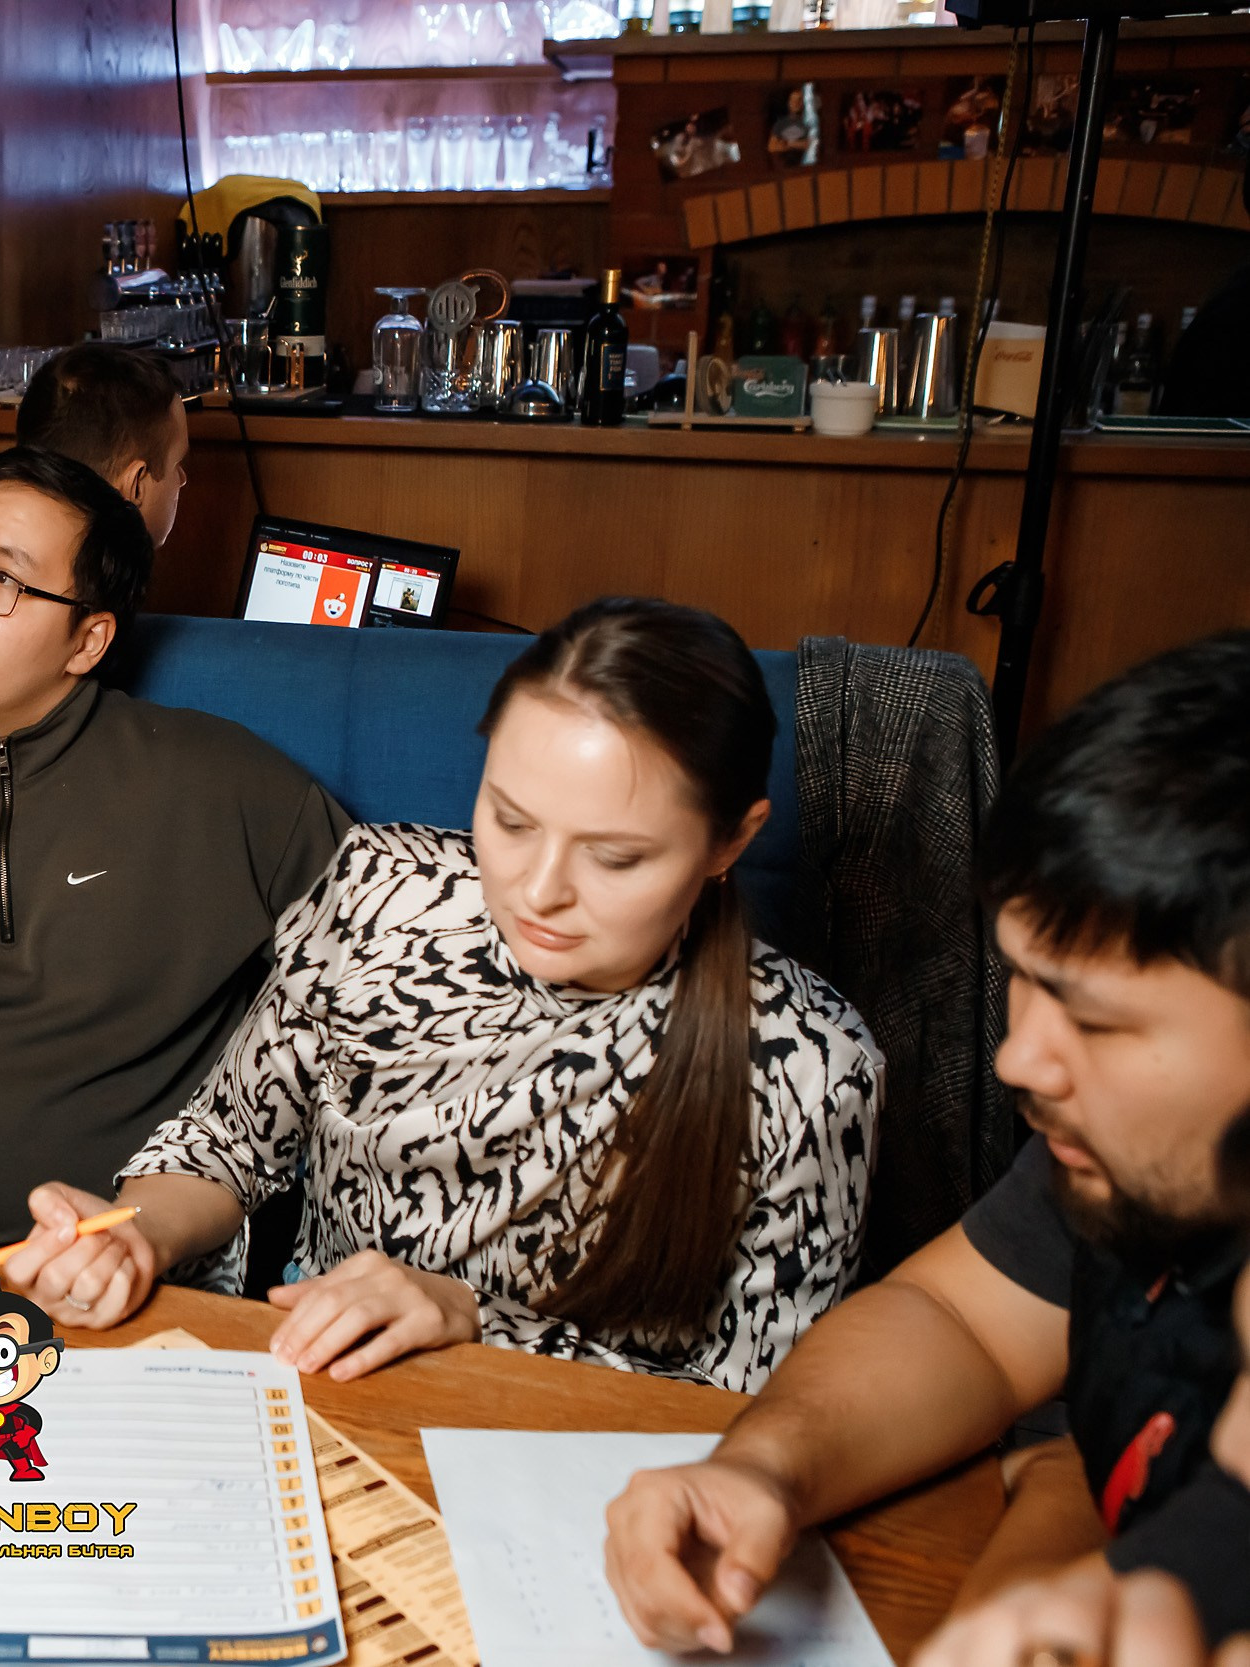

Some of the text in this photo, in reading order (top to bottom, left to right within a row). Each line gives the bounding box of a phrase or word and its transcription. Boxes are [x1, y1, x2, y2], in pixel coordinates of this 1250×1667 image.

[279, 276, 318, 289] Glenfiddich
[743, 379, 795, 397] Carlsberg
[264, 566, 294, 579] платформу
